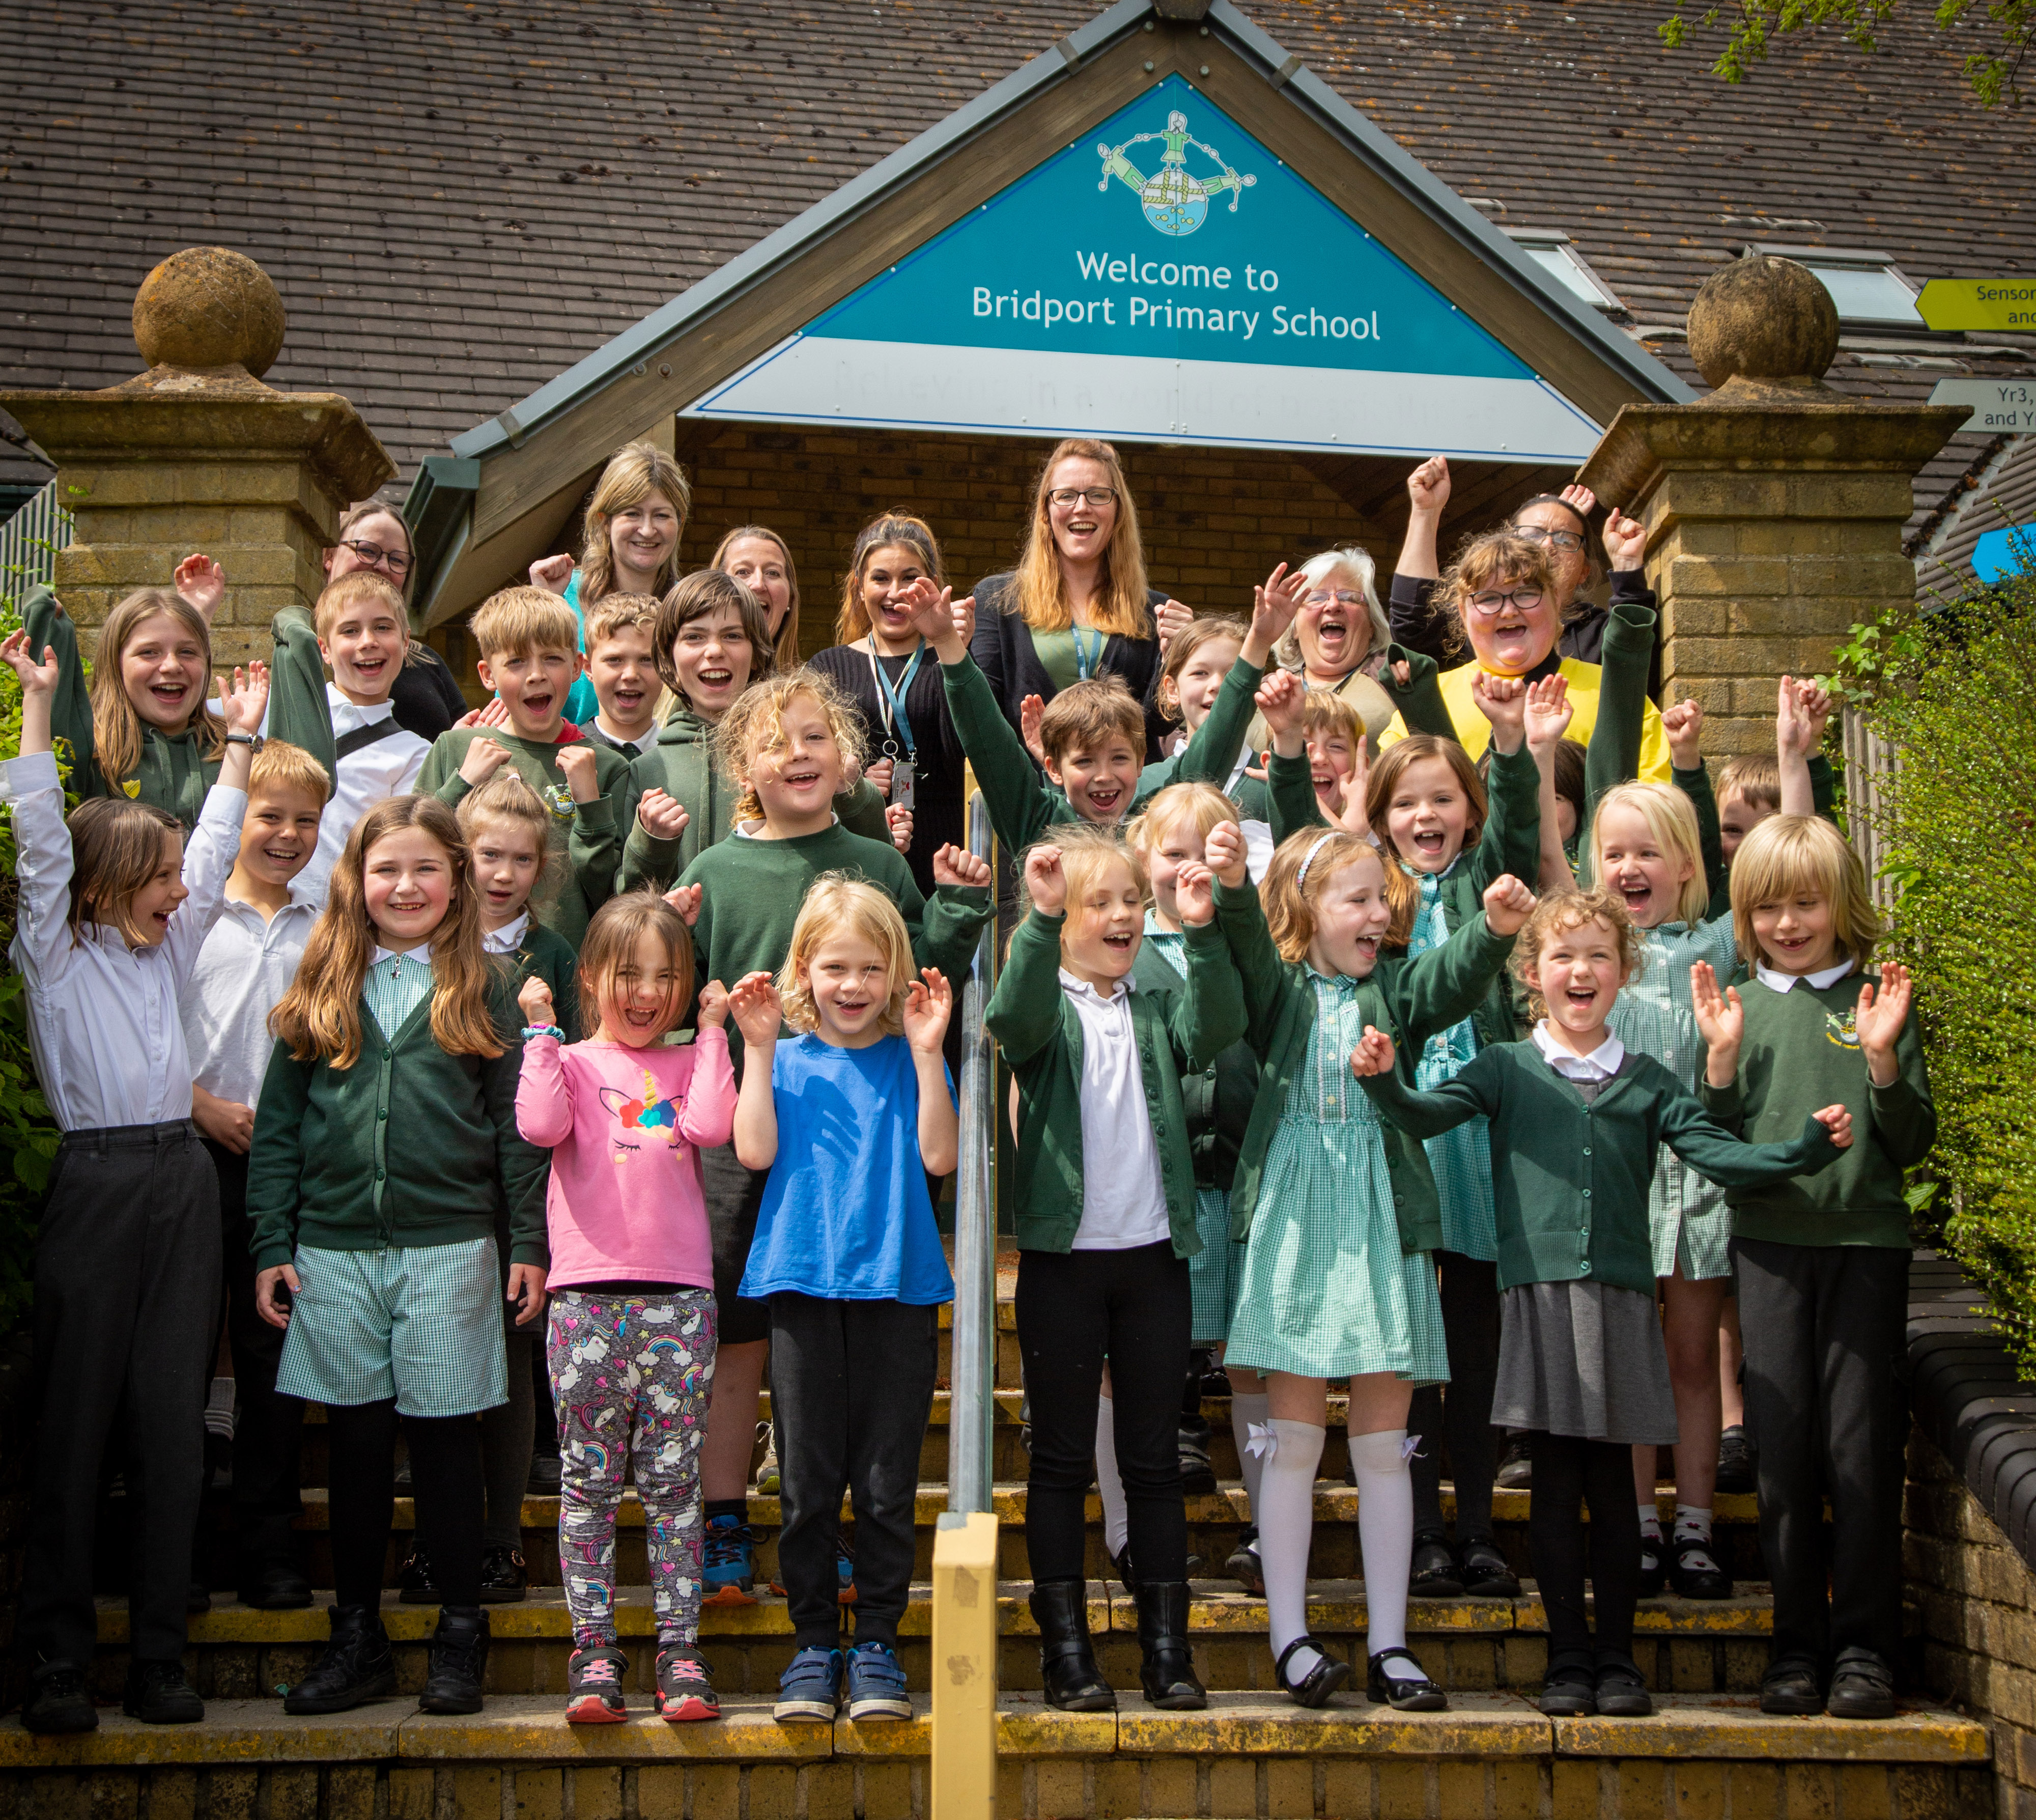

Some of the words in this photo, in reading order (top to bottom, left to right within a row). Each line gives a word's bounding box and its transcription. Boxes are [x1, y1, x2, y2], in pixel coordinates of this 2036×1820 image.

[1077, 250, 1231, 289] Welcome
[1245, 264, 1279, 292] to
[973, 287, 1116, 328] Bridport
[1130, 297, 1260, 340] Primary
[1272, 305, 1380, 340] School
[1998, 387, 2033, 405] Yr3,
[1985, 410, 2017, 425] and
